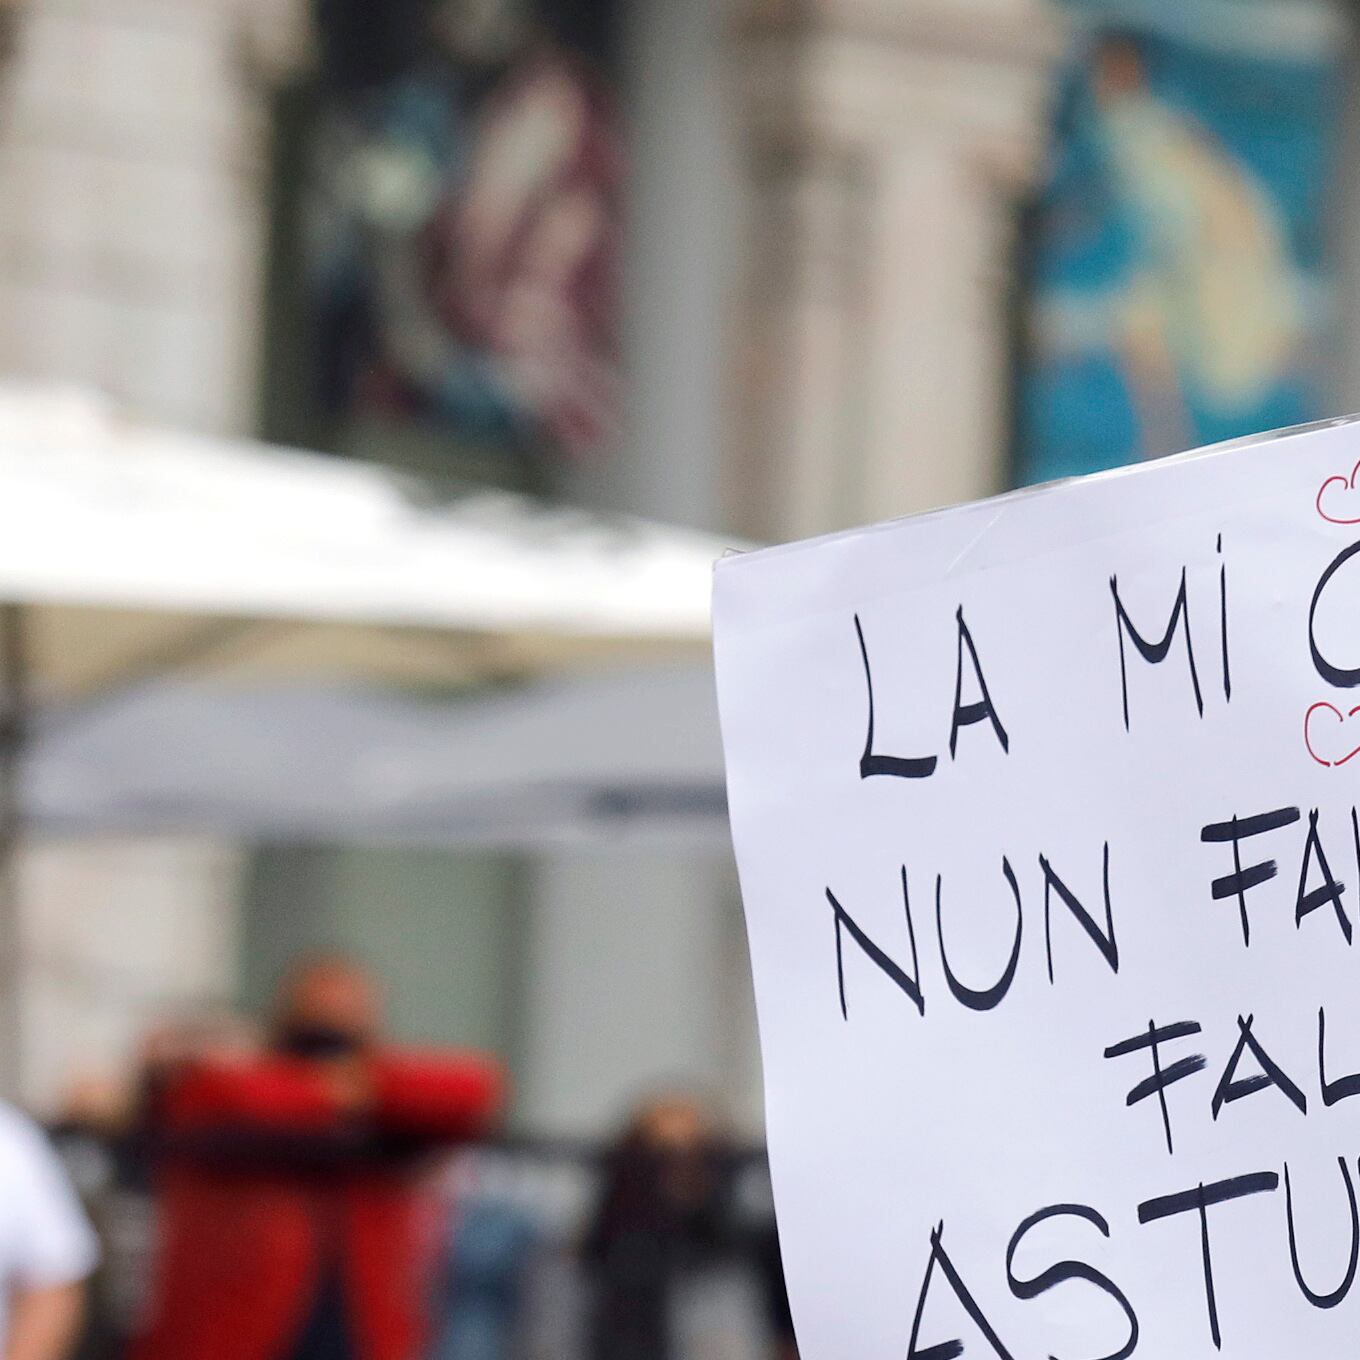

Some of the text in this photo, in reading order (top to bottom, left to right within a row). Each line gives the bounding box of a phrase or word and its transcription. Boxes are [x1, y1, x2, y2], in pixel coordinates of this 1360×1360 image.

[854, 604, 1010, 779] LA
[1109, 533, 1232, 731] MI
[825, 841, 1119, 1021] NUN
